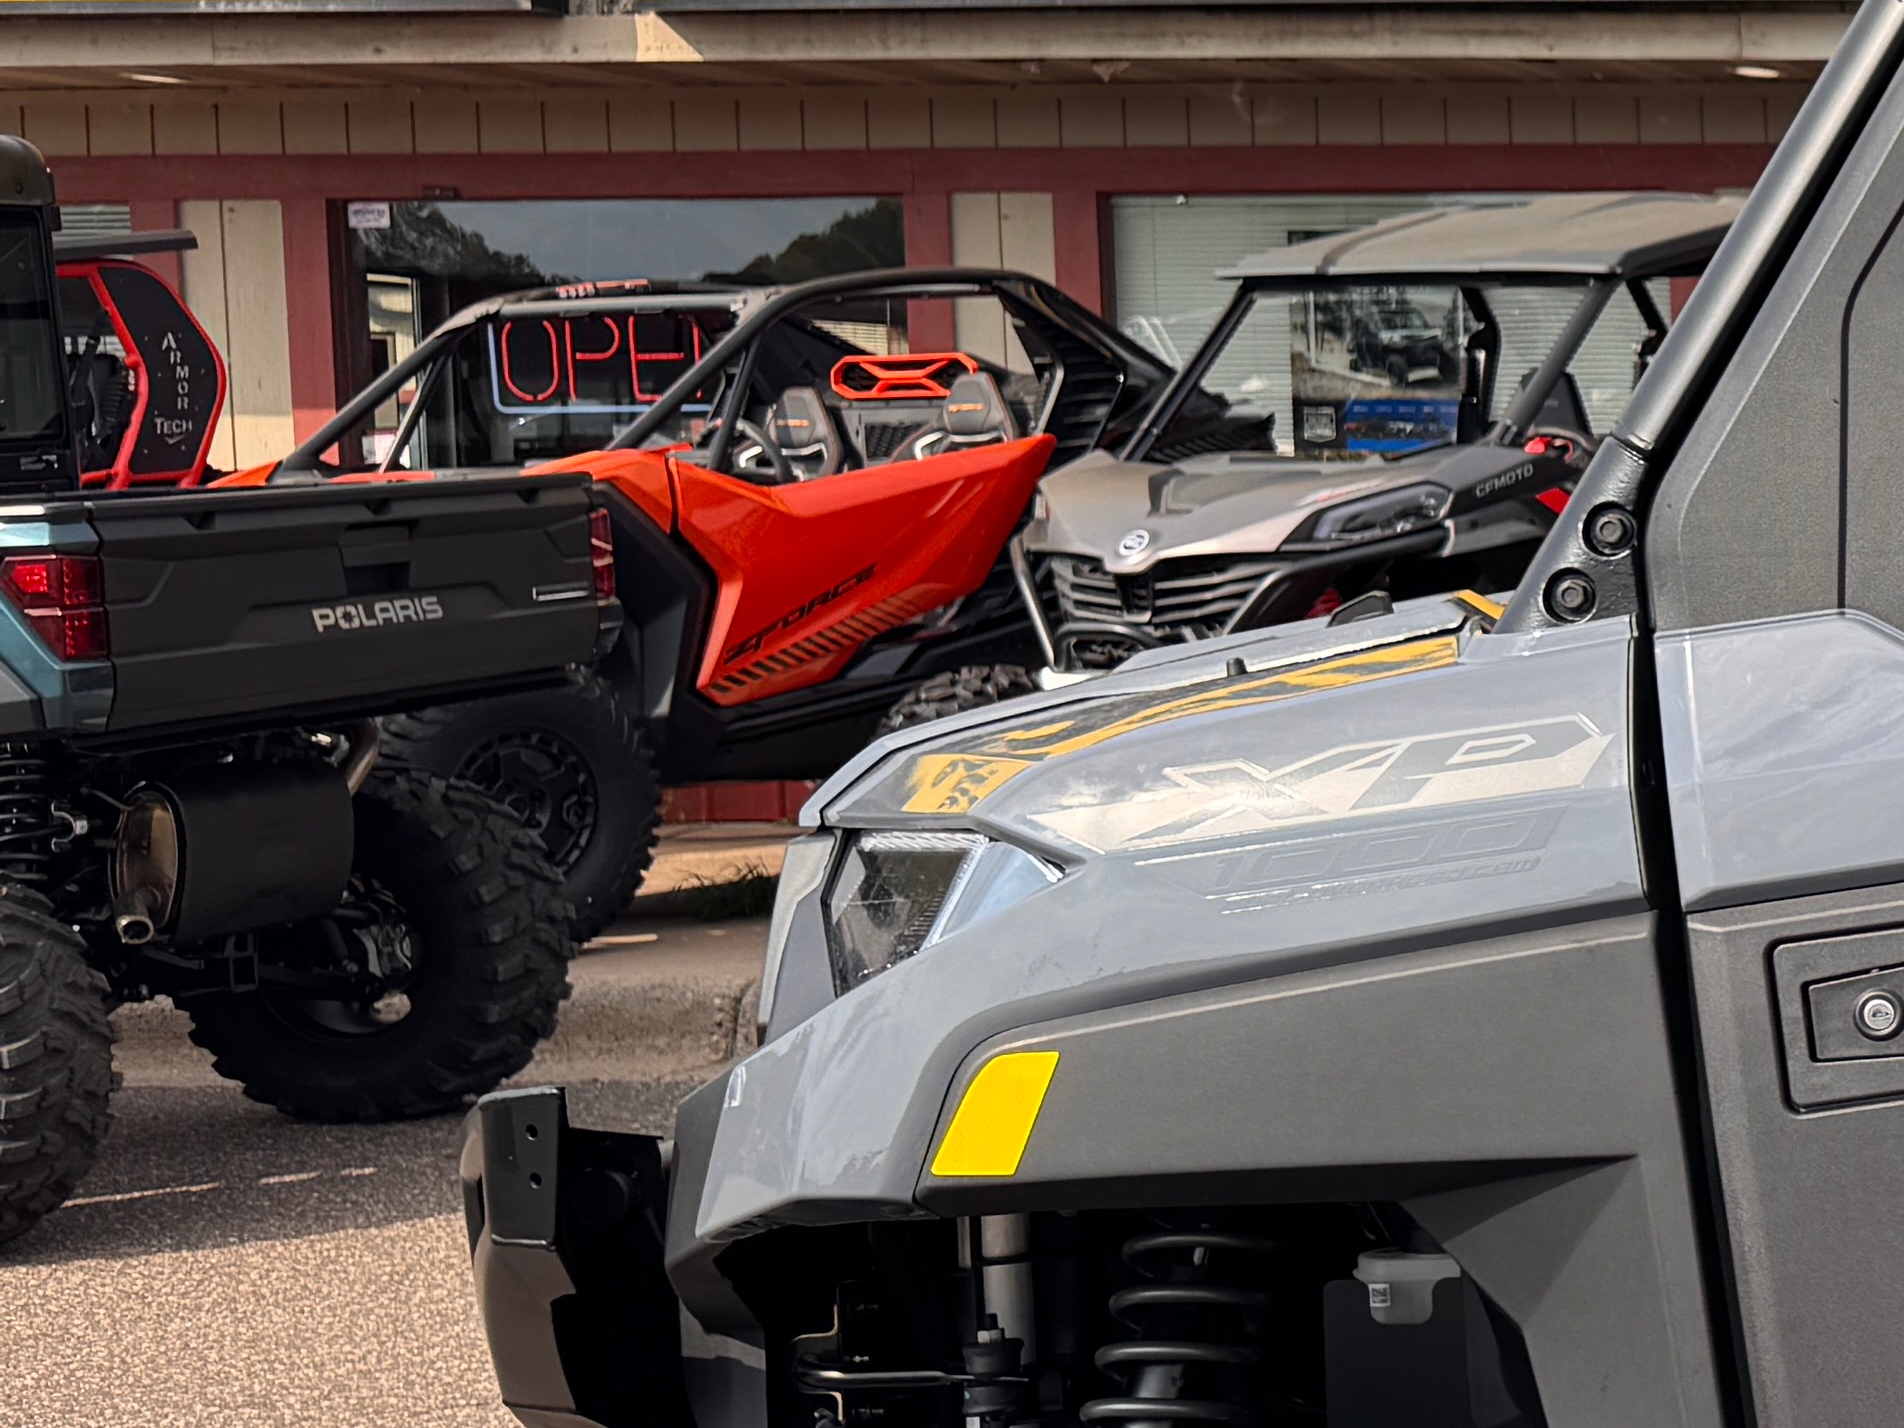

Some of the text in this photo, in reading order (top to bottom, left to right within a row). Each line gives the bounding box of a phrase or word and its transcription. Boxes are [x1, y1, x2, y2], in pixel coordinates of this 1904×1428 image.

[154, 417, 193, 435] TECH
[1475, 463, 1534, 499] CFMOTO
[311, 595, 444, 633] POLARIS
